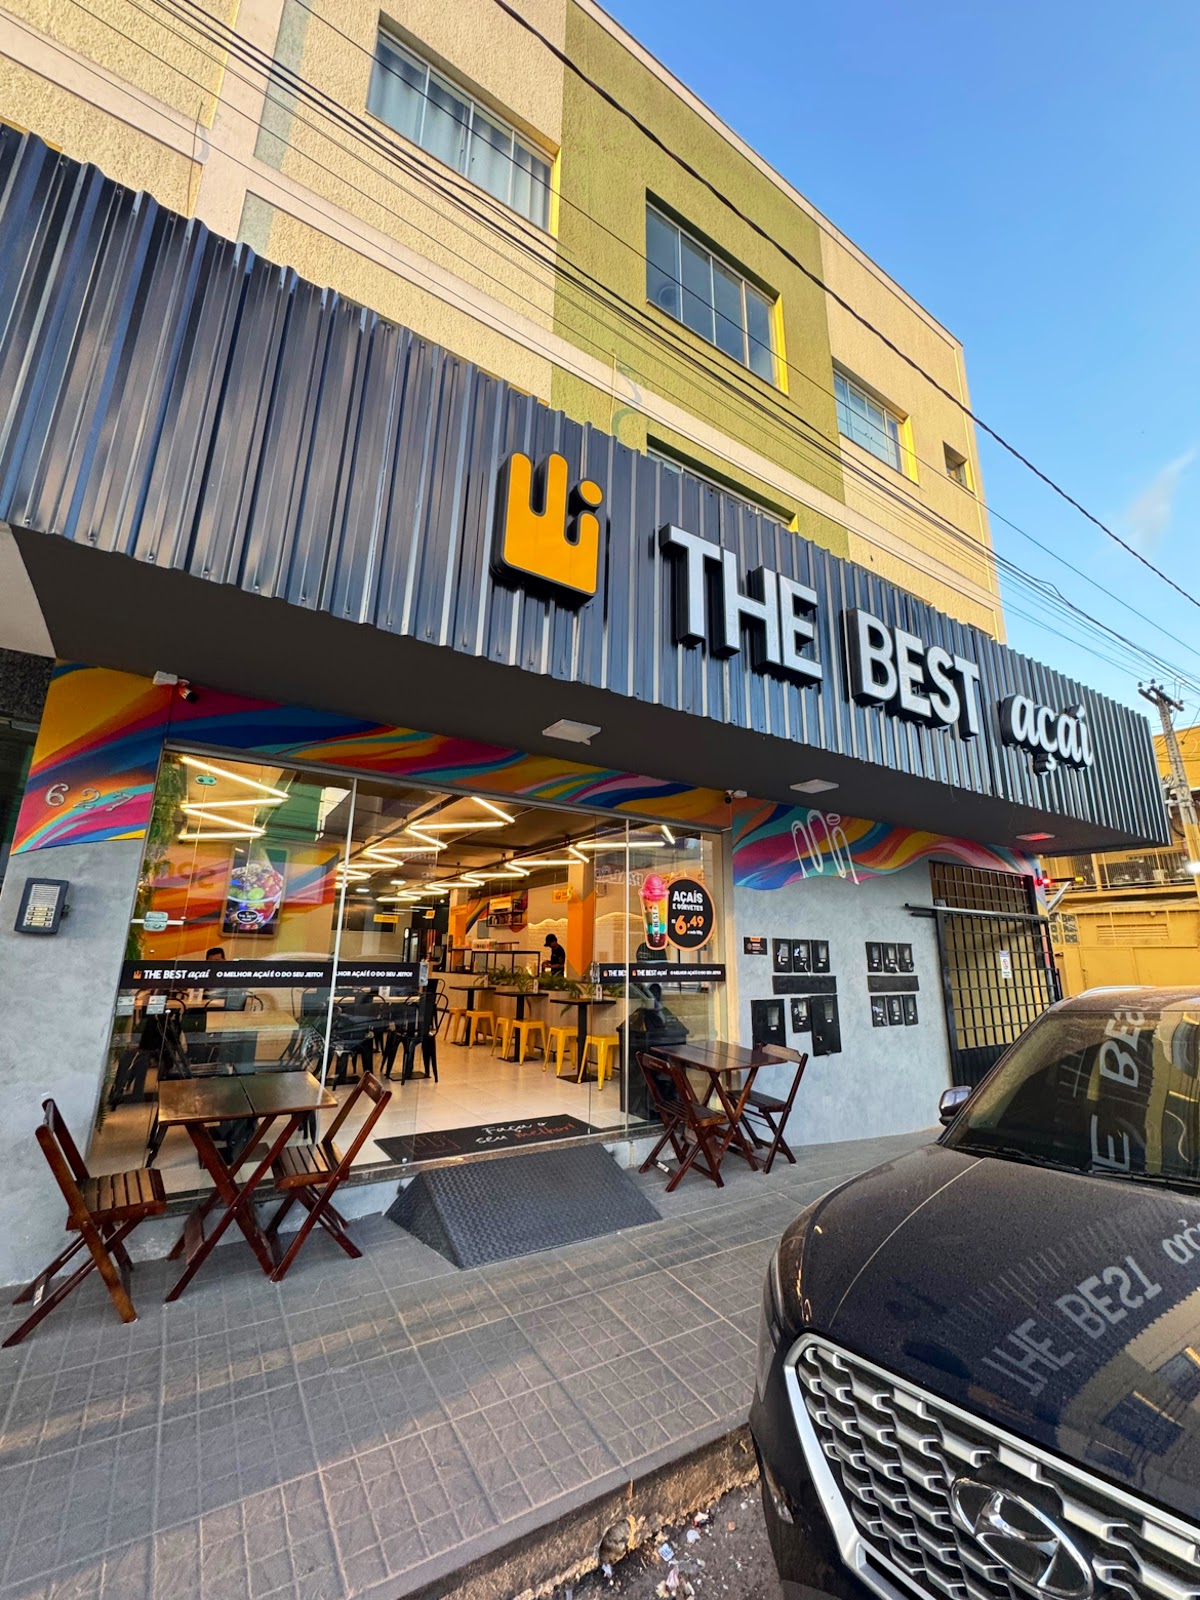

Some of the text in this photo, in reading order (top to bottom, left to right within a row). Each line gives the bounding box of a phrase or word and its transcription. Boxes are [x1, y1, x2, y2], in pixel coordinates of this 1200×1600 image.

[661, 523, 1094, 773] THE BEST açaí
[672, 890, 704, 904] AÇAÍS
[675, 915, 704, 935] 6,49
[143, 968, 211, 981] THE BEST açaí
